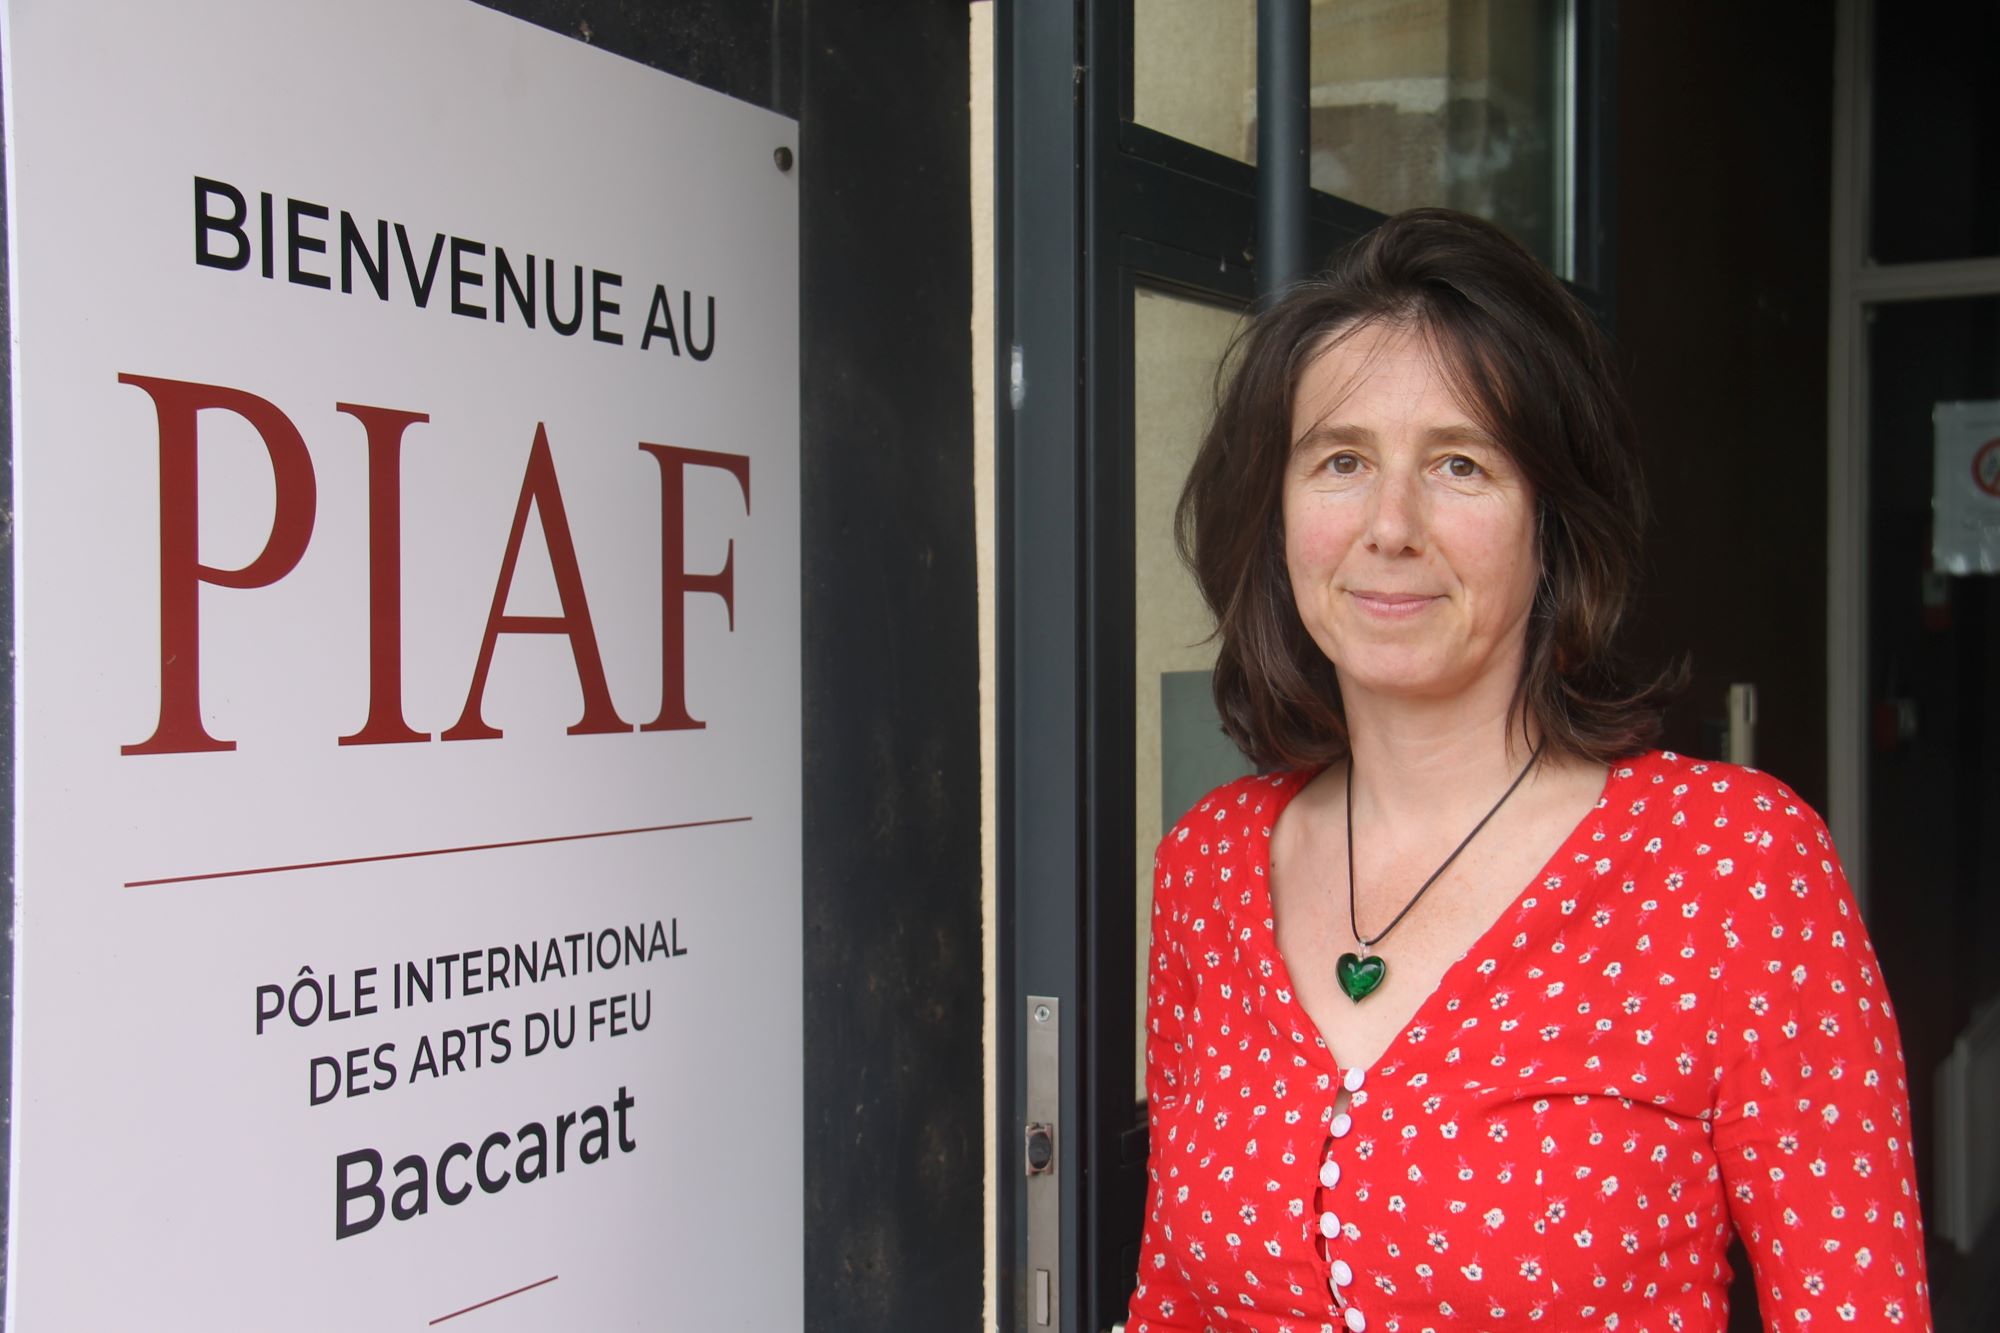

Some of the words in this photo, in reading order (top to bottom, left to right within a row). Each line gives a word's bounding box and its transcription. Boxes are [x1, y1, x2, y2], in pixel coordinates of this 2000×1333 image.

[193, 175, 624, 347] BIENVENUE
[639, 283, 716, 363] AU
[117, 372, 751, 756] PIAF
[256, 965, 379, 1036] PÔLE
[393, 917, 688, 1010] INTERNATIONAL
[309, 1042, 397, 1107] DES
[408, 1018, 512, 1084] ARTS
[524, 1004, 577, 1057] DU
[588, 989, 652, 1042] FEU
[335, 1085, 637, 1241] Baccarat
